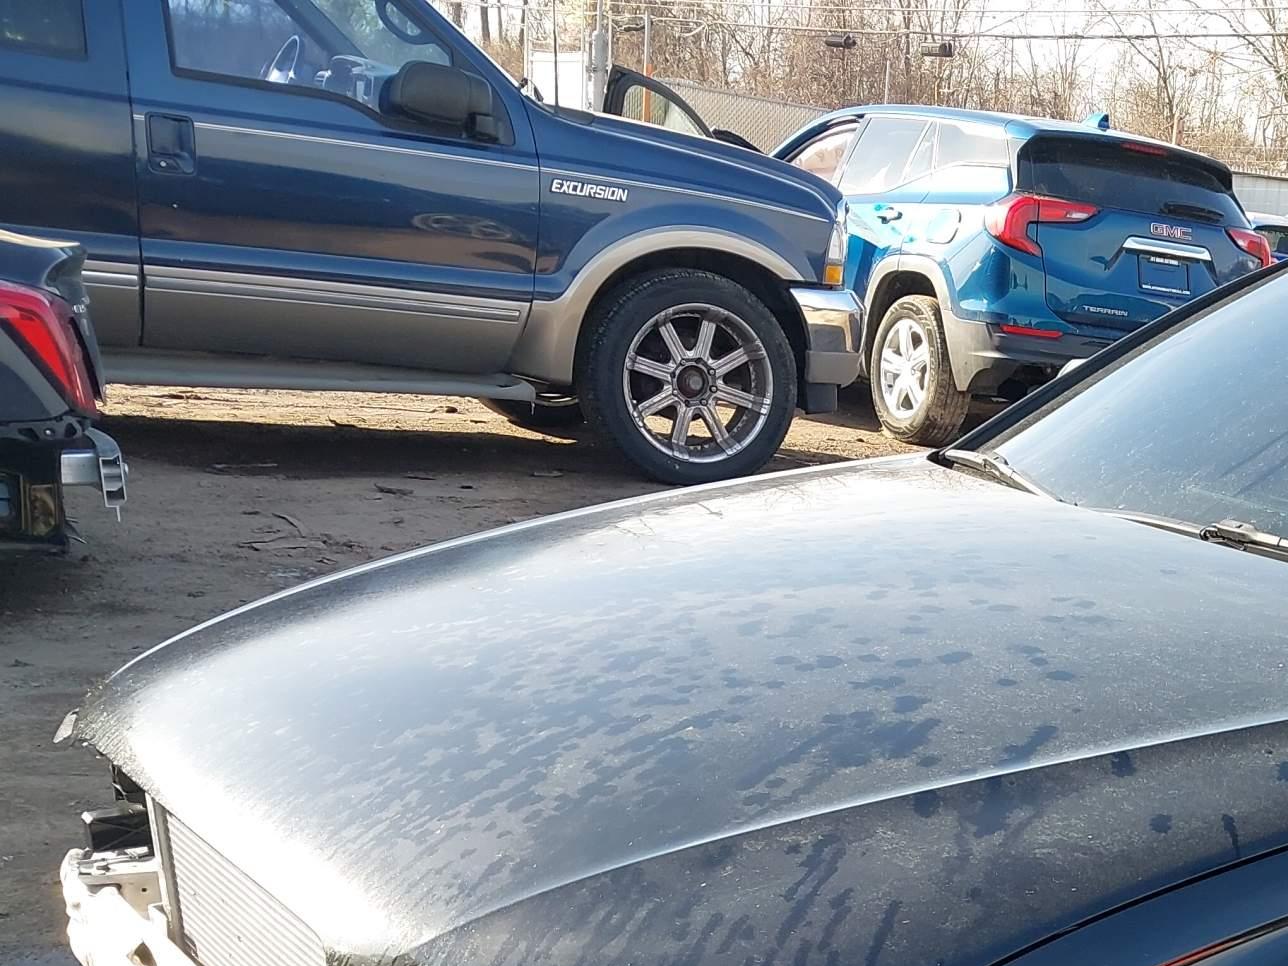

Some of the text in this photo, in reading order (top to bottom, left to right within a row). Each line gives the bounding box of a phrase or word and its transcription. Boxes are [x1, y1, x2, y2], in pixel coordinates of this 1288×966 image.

[551, 179, 628, 202] EXCURSION
[1151, 222, 1192, 240] GMC
[1083, 305, 1128, 316] TERRAIN
